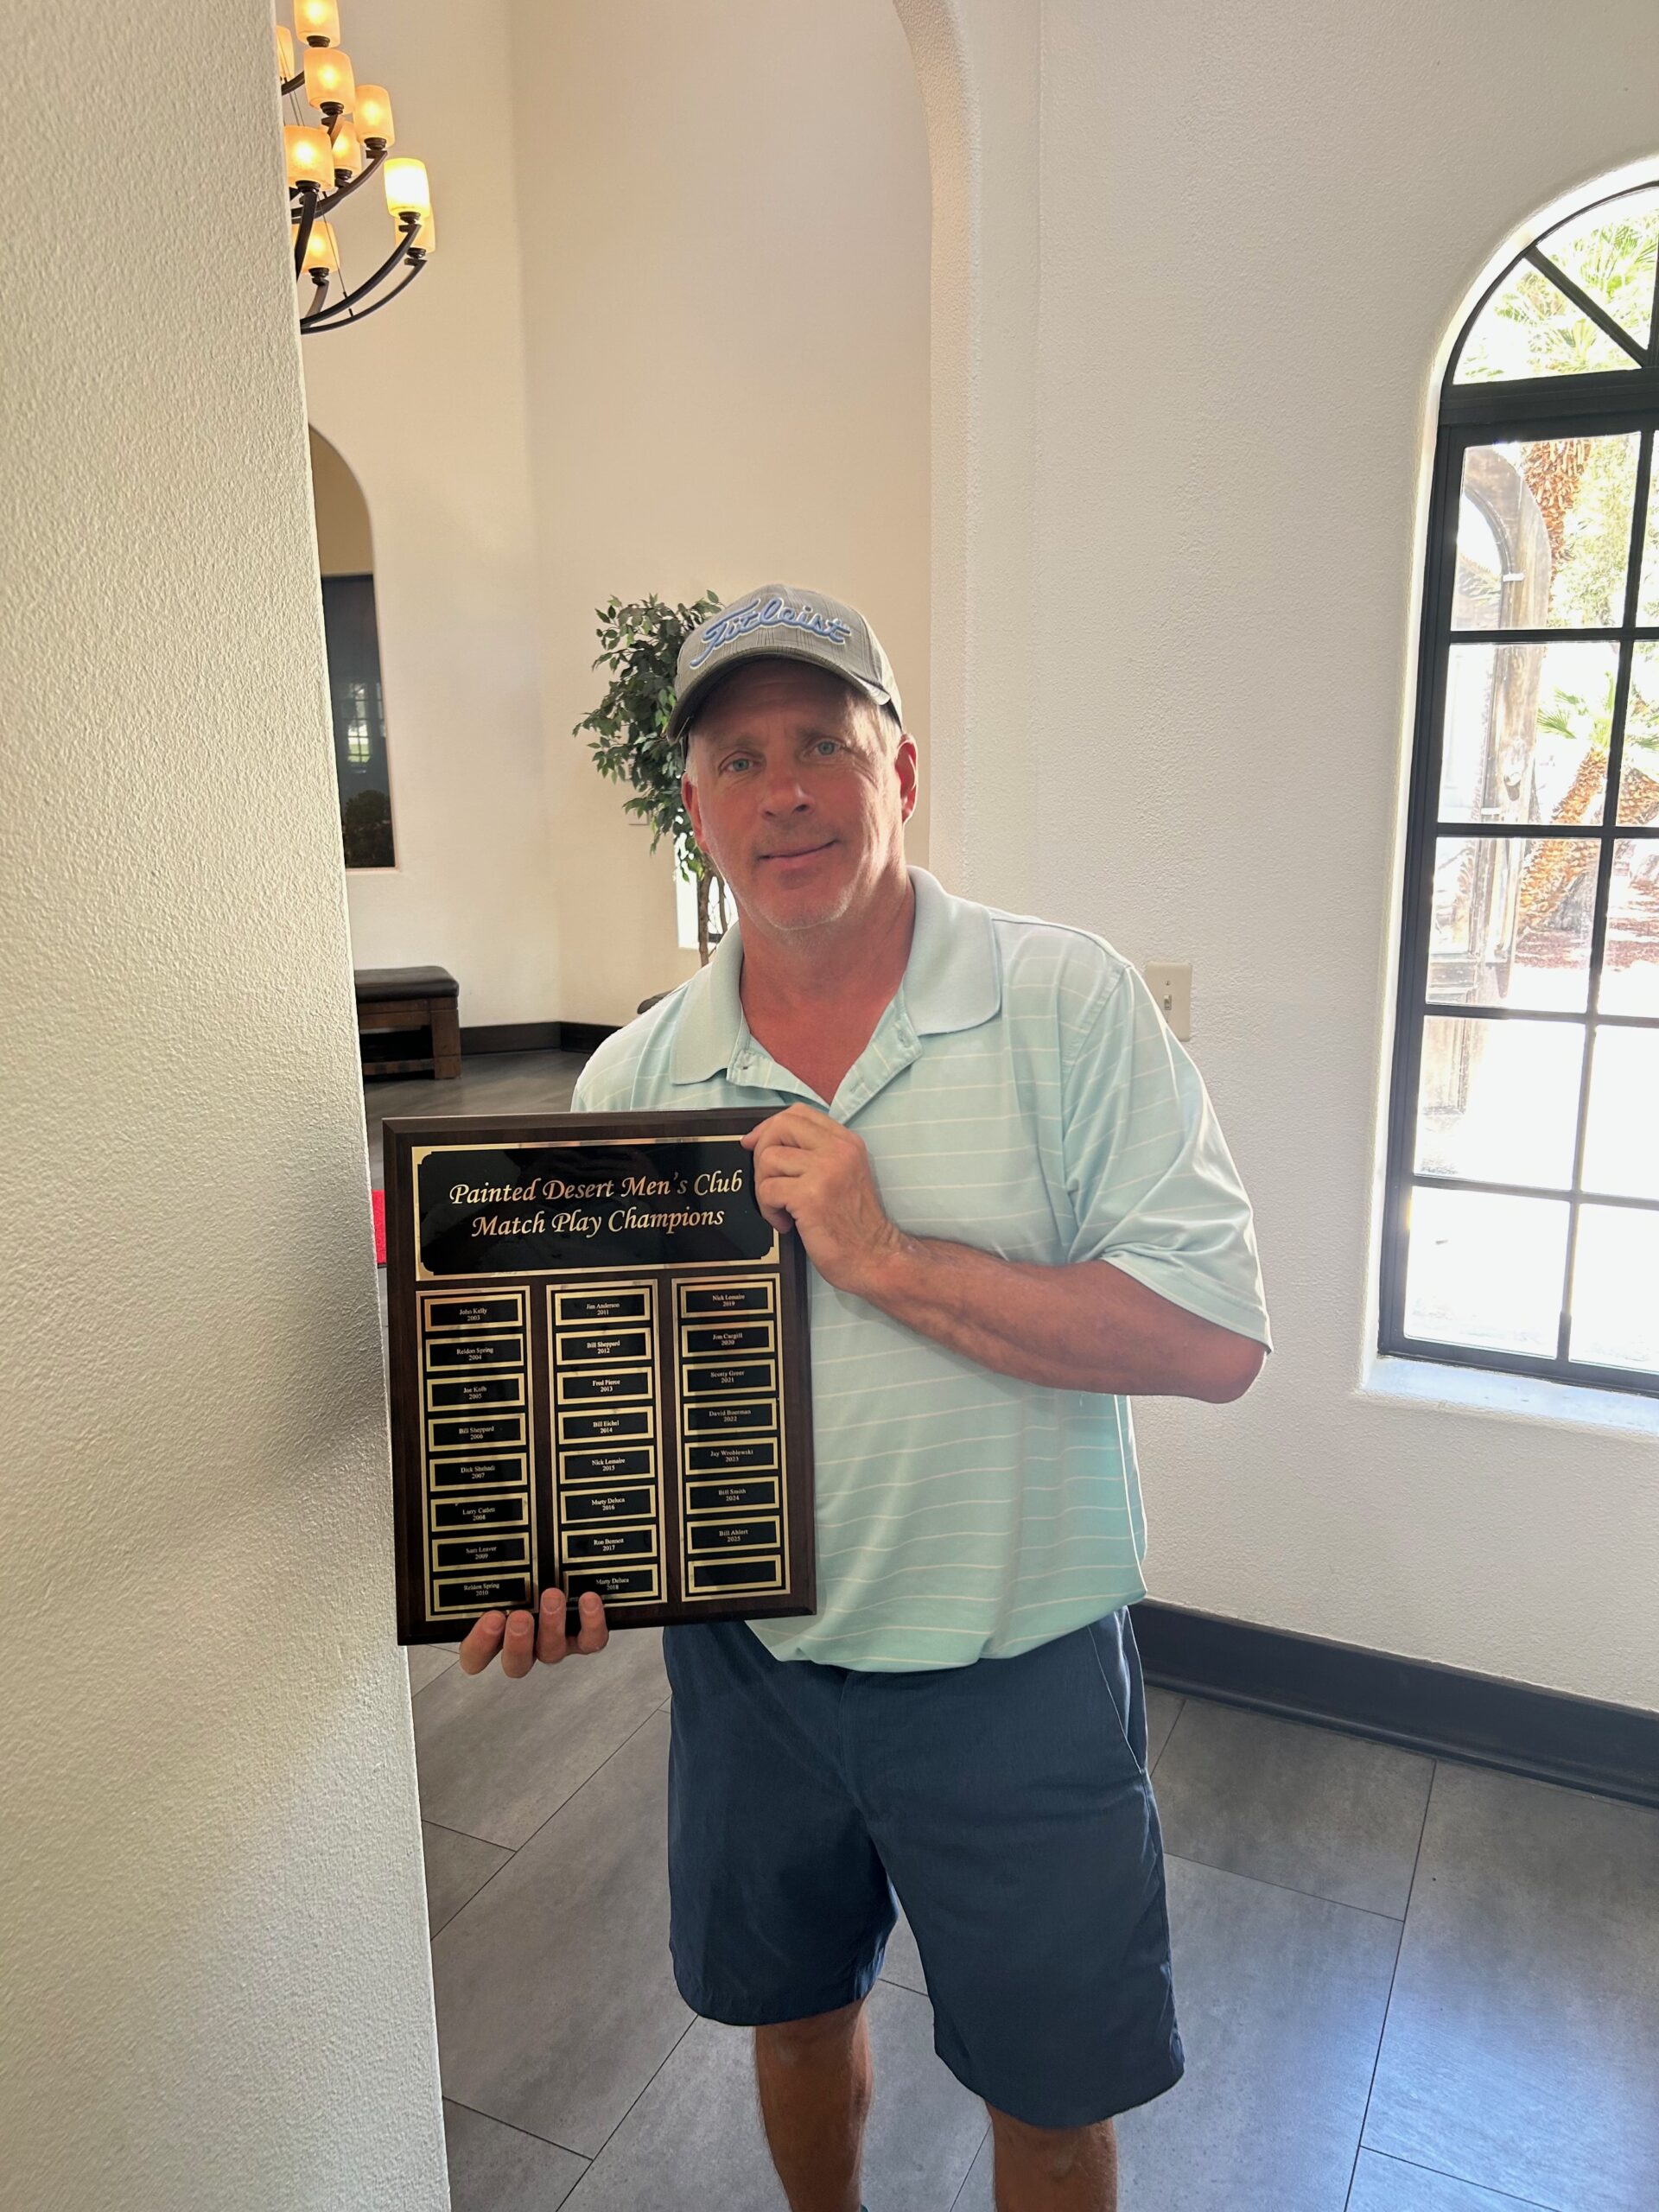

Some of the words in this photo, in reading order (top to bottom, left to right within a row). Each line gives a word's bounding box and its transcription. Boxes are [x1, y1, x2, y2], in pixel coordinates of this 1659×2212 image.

[690, 597, 852, 670] Titleist
[449, 1178, 541, 1205] Painted
[542, 1179, 614, 1201] Desert
[620, 1172, 688, 1198] Men's
[693, 1169, 743, 1197] Club
[471, 1210, 546, 1237] Match
[551, 1209, 601, 1237] Play
[607, 1205, 724, 1235] Champions
